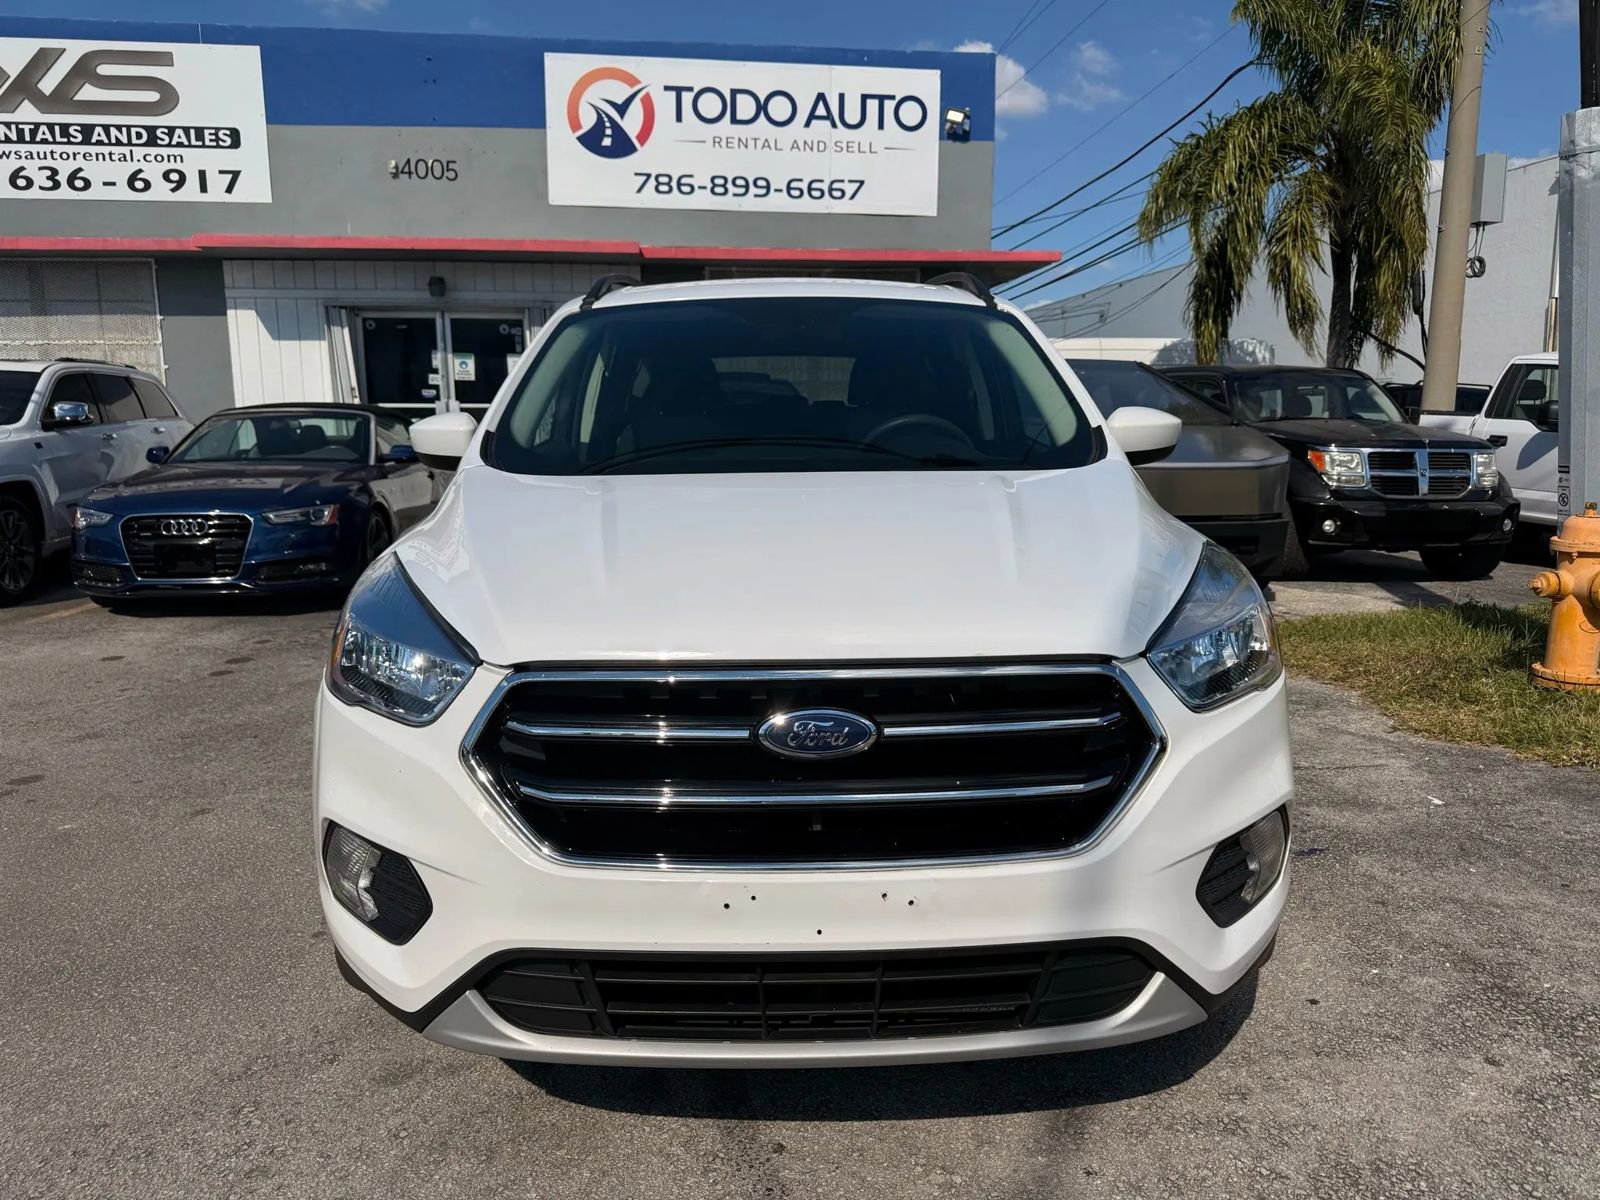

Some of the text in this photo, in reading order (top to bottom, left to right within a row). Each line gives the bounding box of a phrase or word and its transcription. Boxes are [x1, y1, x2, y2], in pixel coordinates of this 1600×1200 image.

[663, 85, 928, 132] TODO AUTO
[90, 126, 148, 145] AND
[156, 128, 232, 147] SALES
[712, 135, 878, 154] RENTAL AND SELL
[8, 165, 242, 195] 636-6917
[400, 157, 459, 181] 4005
[634, 172, 866, 201] 786-899-6667
[786, 720, 849, 747] Ford
